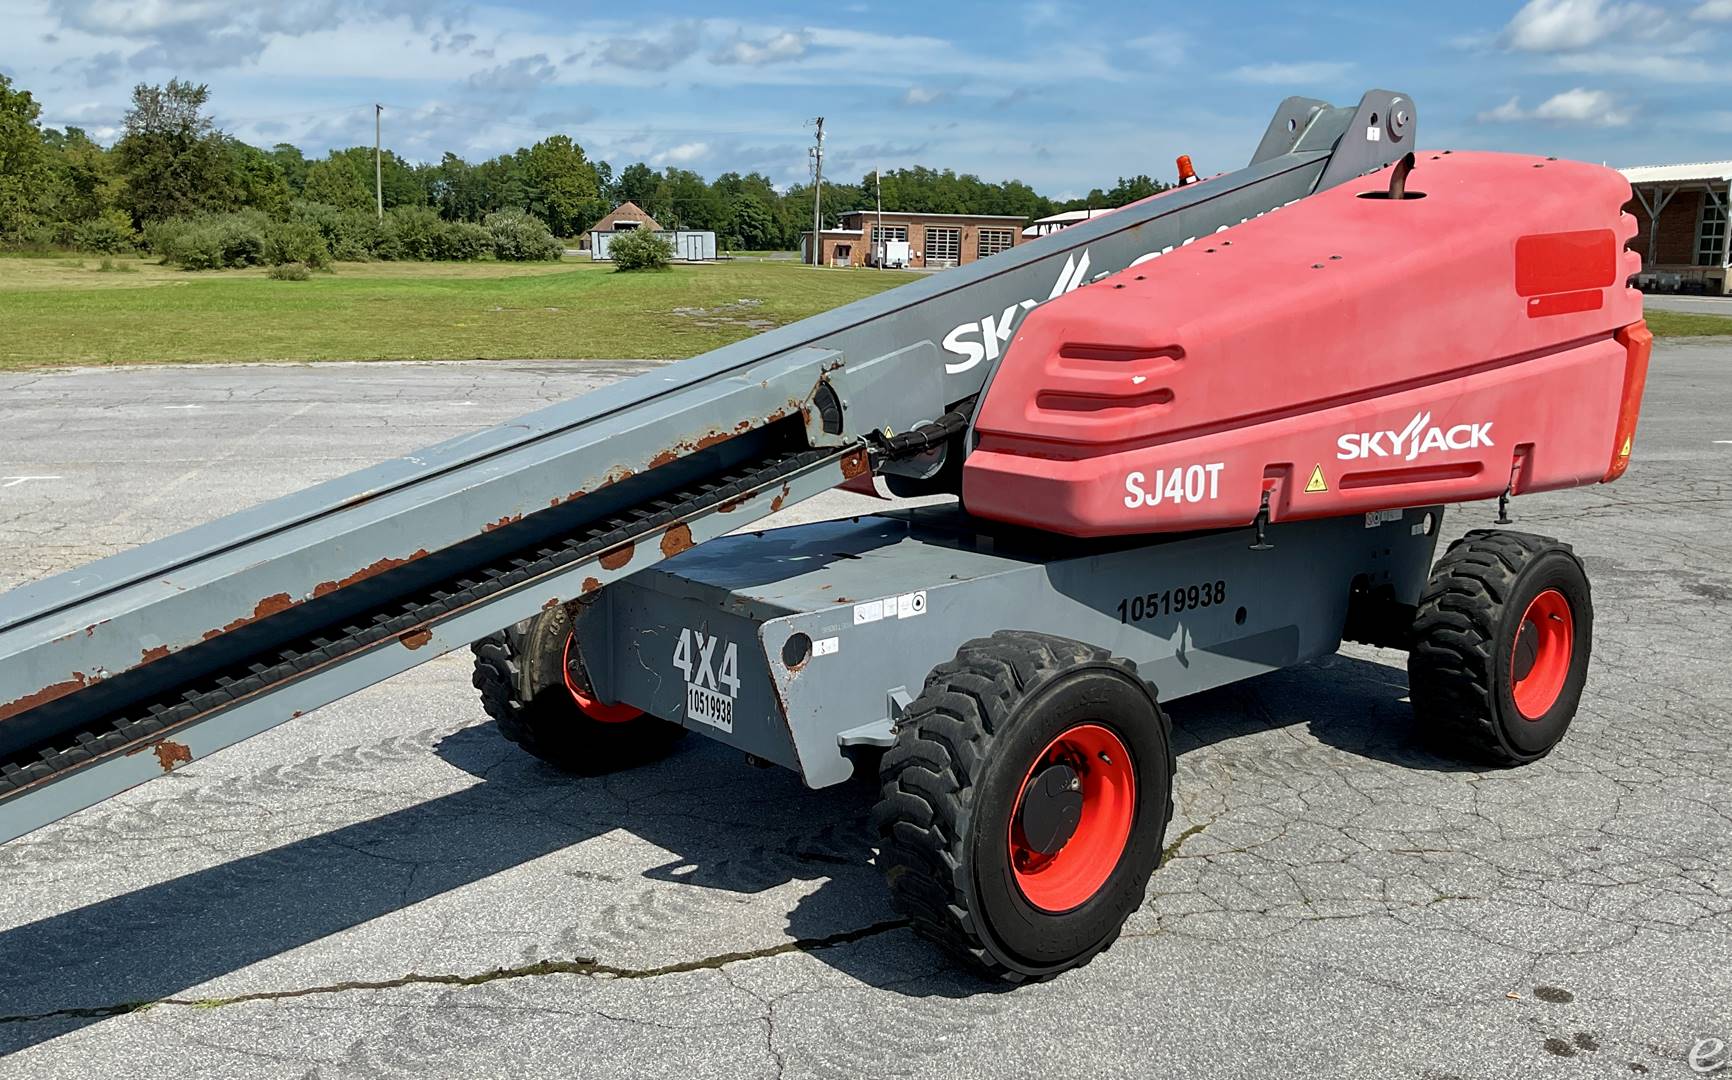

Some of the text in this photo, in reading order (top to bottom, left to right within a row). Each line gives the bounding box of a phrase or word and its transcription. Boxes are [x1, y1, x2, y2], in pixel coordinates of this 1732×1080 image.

[1337, 411, 1494, 461] SKYJACK
[1124, 463, 1224, 508] SJ40T
[1117, 580, 1225, 624] 10519938
[673, 628, 740, 699] 4X4
[689, 689, 731, 725] 10519938
